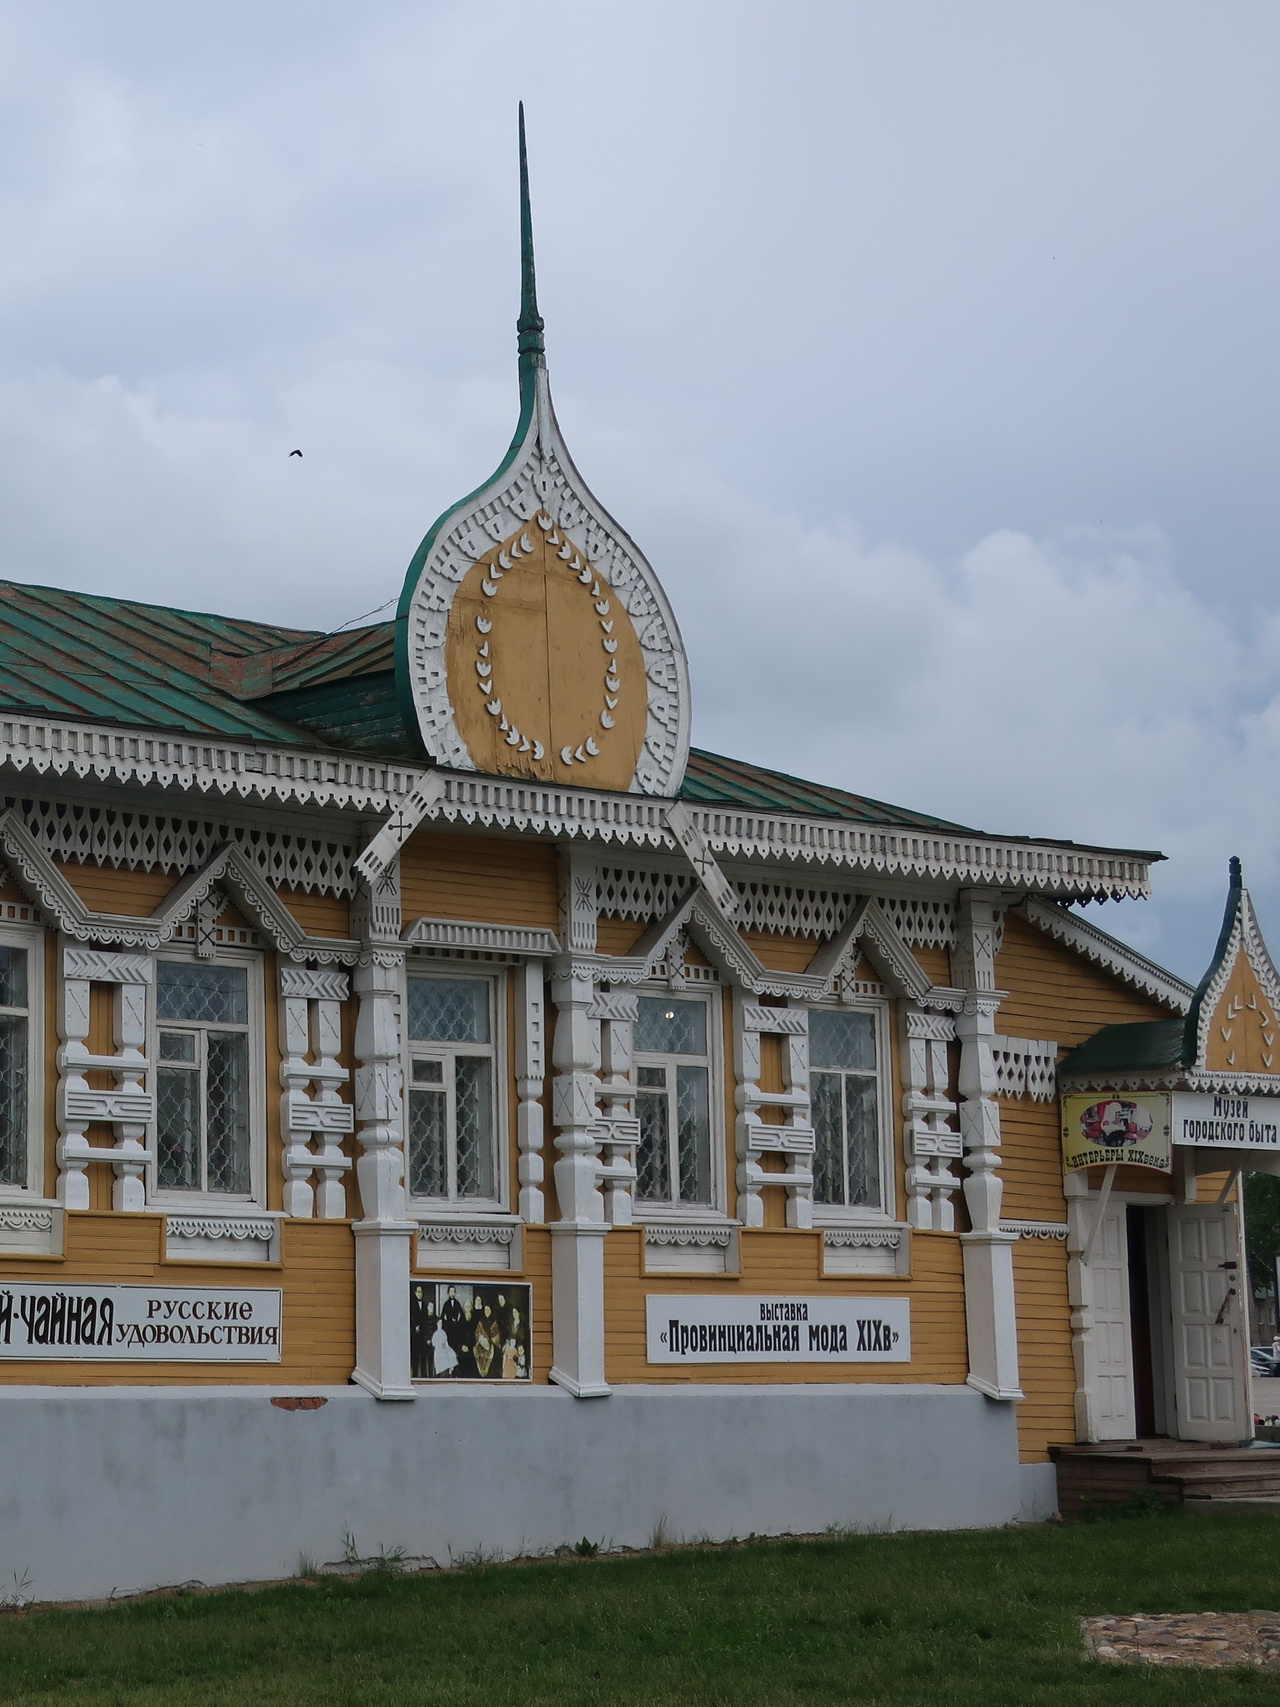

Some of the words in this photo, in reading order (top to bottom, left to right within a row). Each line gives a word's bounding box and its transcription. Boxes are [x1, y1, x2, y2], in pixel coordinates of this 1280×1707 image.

[1213, 1096, 1248, 1119] Музей
[1183, 1119, 1245, 1142] городского
[1248, 1120, 1277, 1144] быта
[759, 1303, 809, 1321] выставка
[115, 1323, 279, 1348] УДОВОЛЬСТВИЯ
[659, 1319, 800, 1355] «Провинциальная
[808, 1324, 847, 1354] мода
